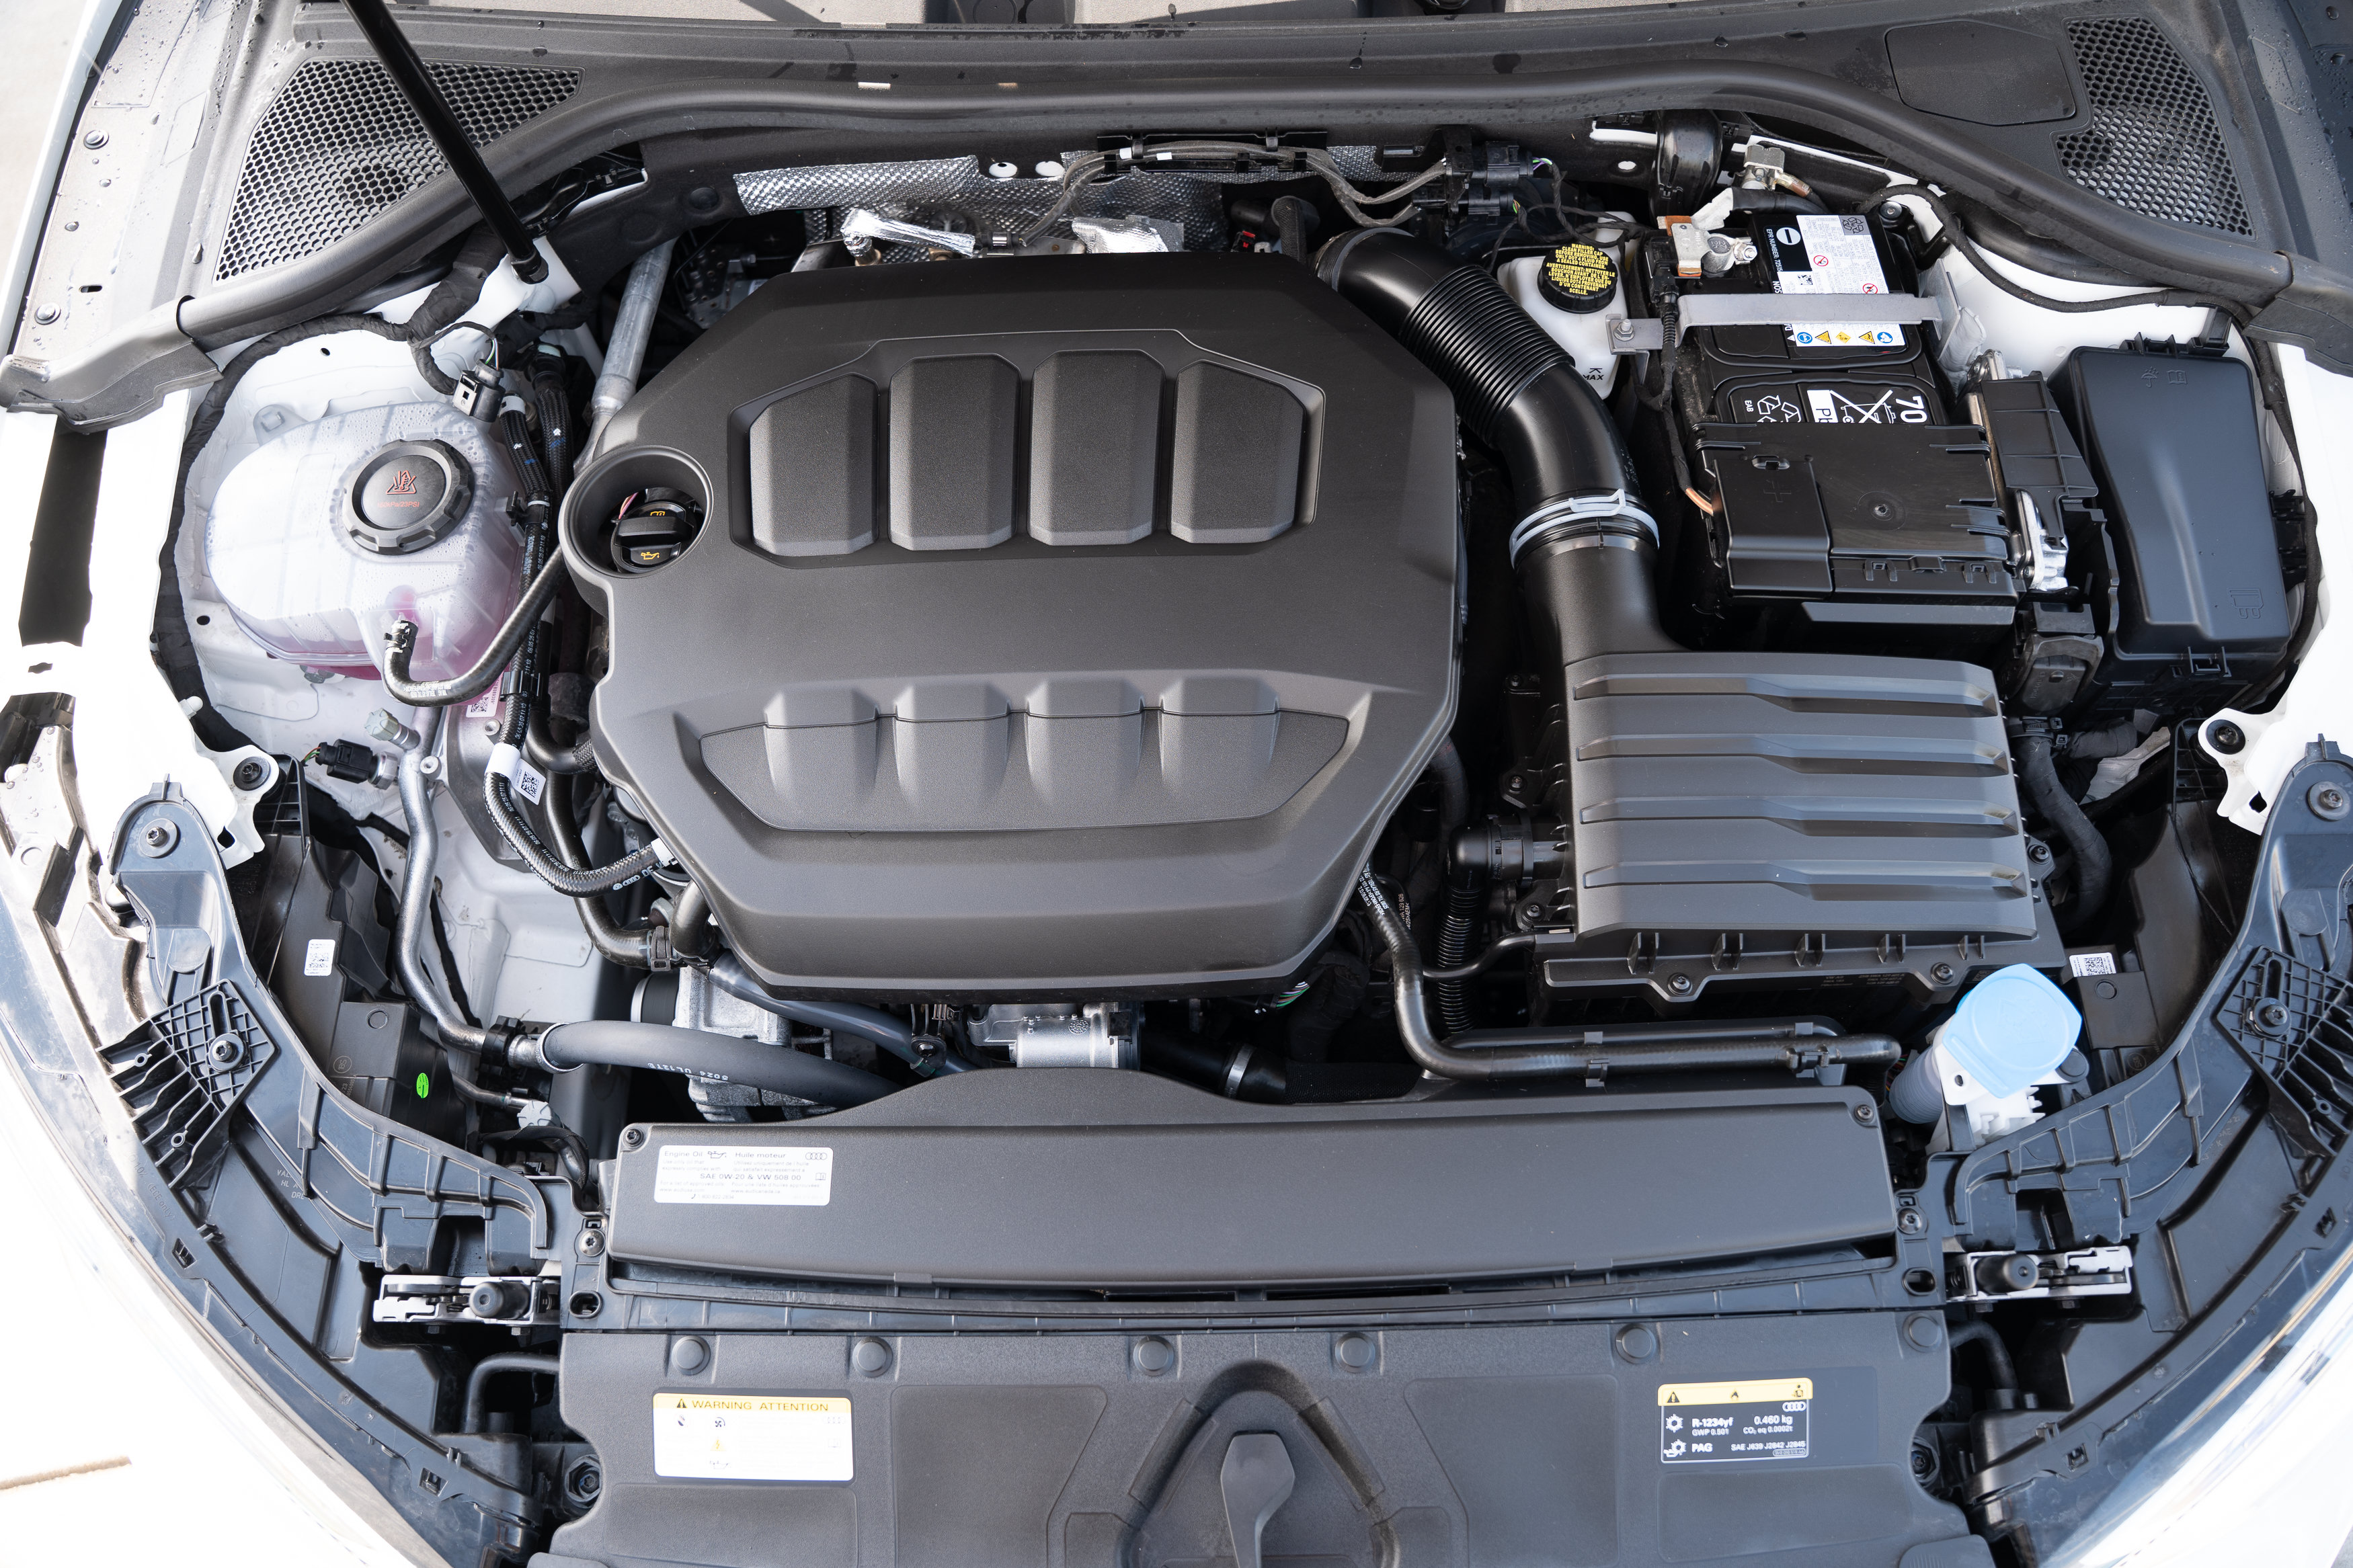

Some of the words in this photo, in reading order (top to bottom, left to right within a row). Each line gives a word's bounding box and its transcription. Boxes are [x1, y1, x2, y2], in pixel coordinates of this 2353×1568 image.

[1766, 229, 1774, 238] EPR
[1551, 267, 1573, 276] BOUCHON
[1571, 284, 1599, 292] CONTENANT
[1582, 280, 1607, 288] PROVENANT
[1745, 400, 1754, 412] EAB
[1896, 396, 1927, 423] 70
[691, 1399, 752, 1410] WARNING
[760, 1402, 829, 1411] ATTENTION
[1691, 1417, 1734, 1428] R-1234yf
[1753, 1415, 1780, 1426] 0.460
[1781, 1415, 1793, 1426] kg
[1691, 1428, 1710, 1437] GWP
[1691, 1443, 1713, 1452] PAG
[1730, 1444, 1746, 1452] SAE
